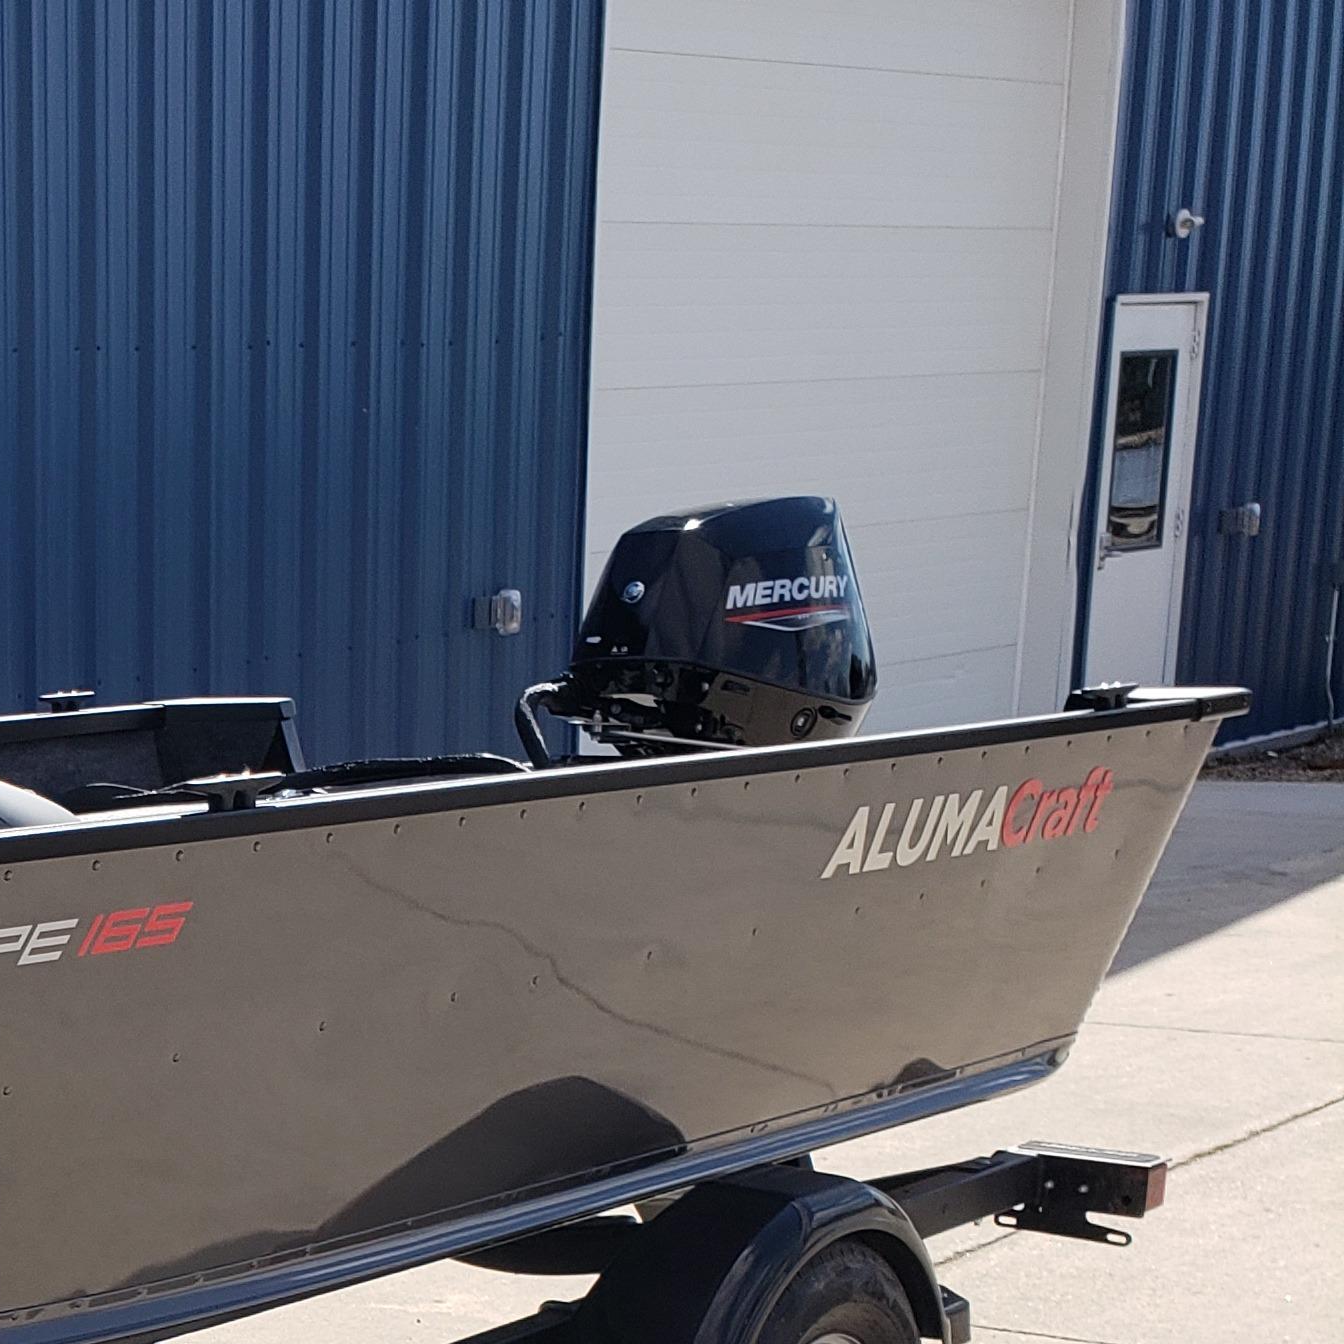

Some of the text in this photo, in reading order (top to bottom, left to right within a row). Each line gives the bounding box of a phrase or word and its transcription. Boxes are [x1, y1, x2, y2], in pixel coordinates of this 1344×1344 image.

[726, 575, 849, 610] MERCURY
[820, 766, 1113, 880] ALUMACraft
[78, 901, 194, 958] 165
